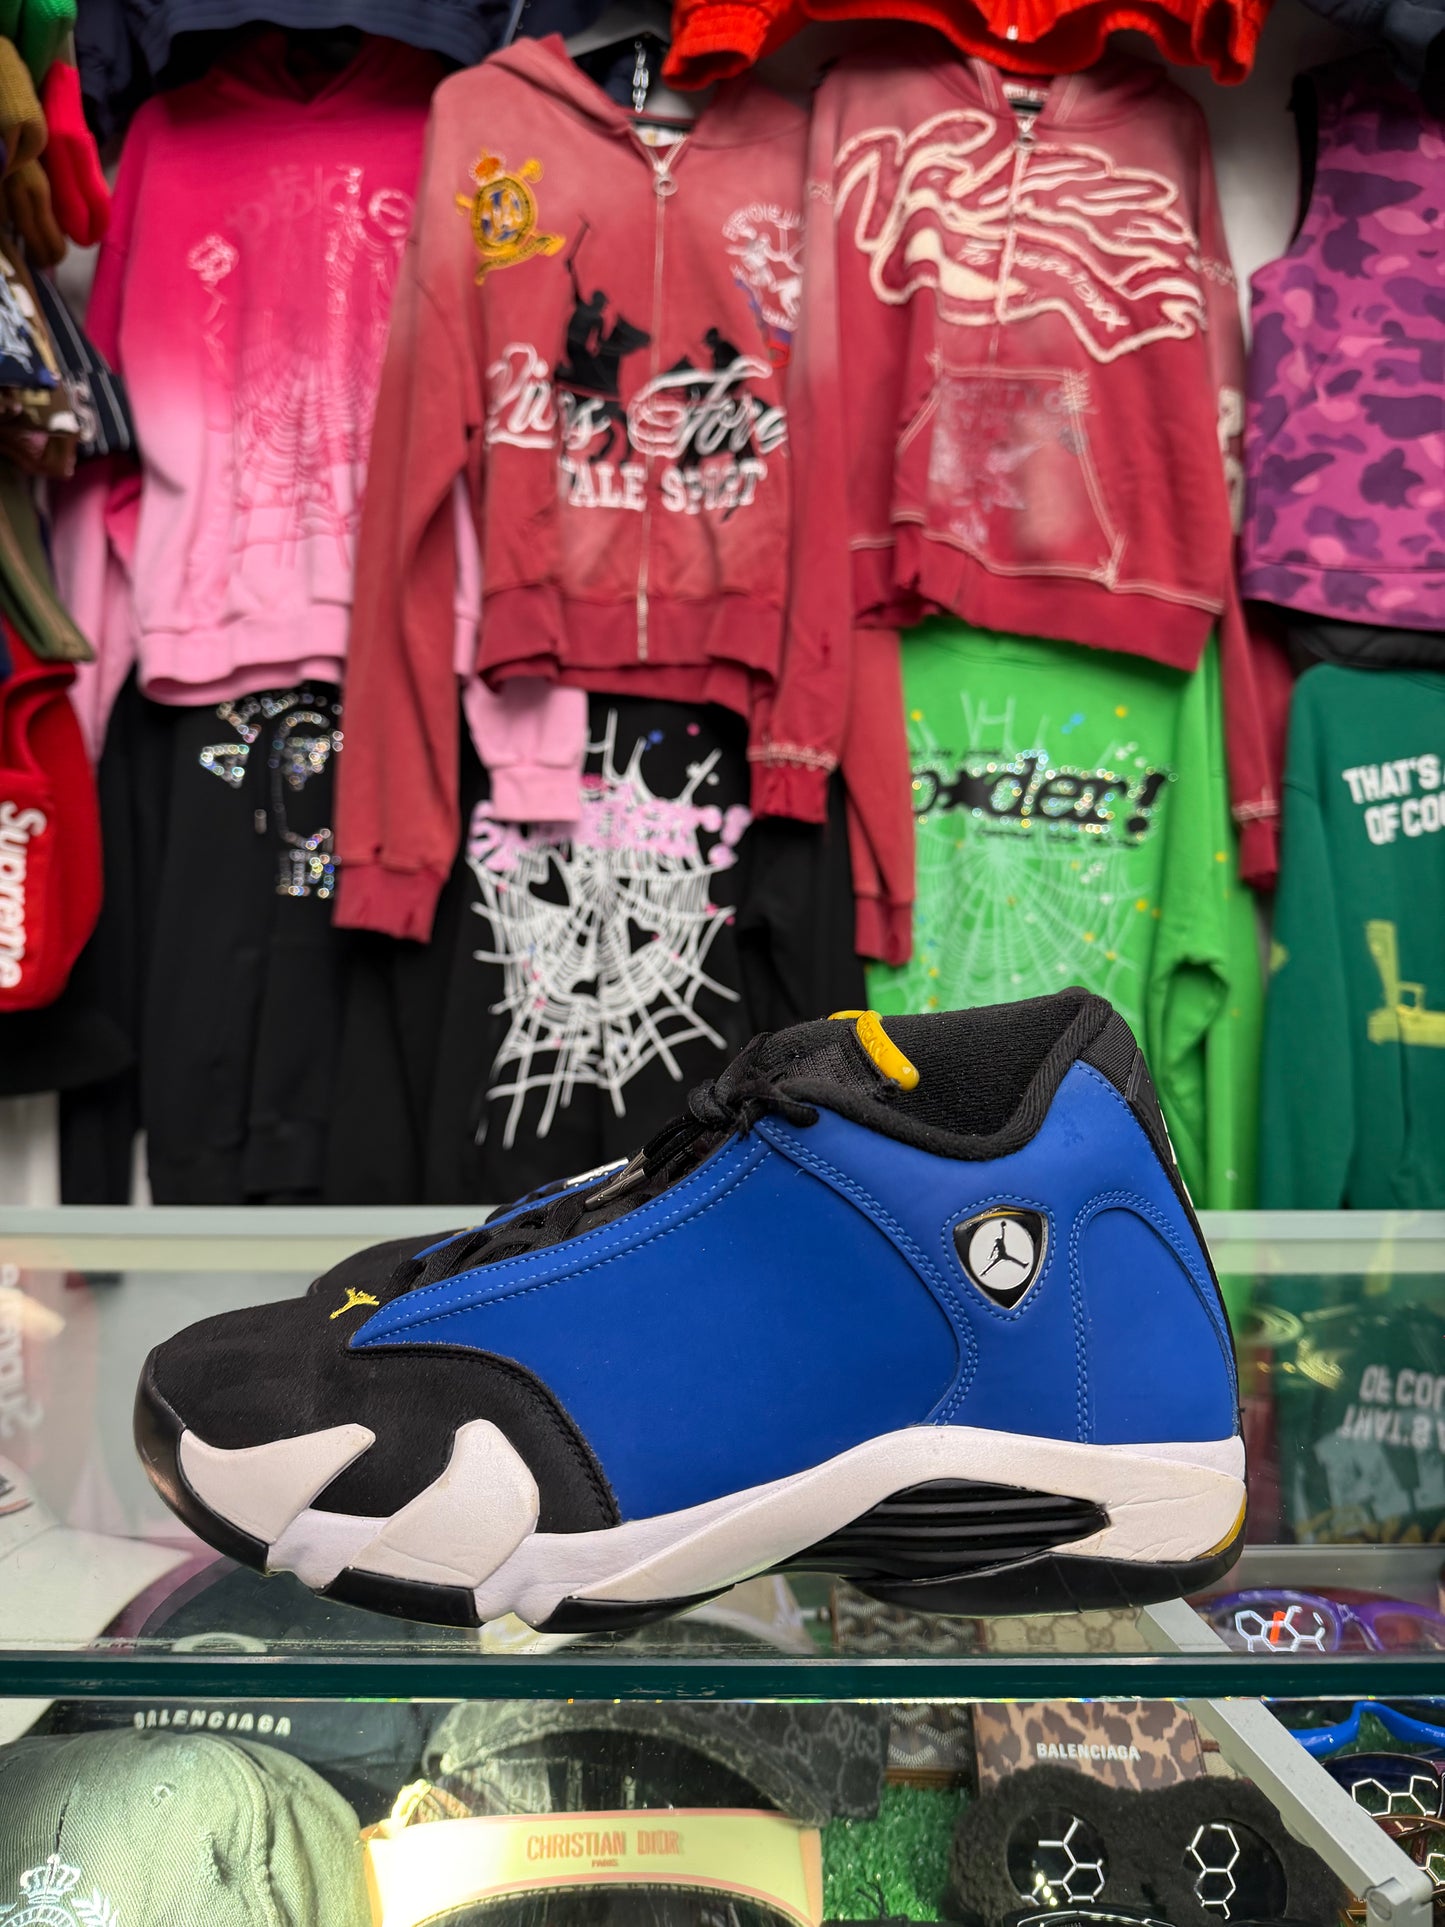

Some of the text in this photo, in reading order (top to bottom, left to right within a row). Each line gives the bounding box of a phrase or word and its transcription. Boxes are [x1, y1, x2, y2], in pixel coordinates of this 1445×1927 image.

[1341, 753, 1441, 805] THAT'S
[1363, 791, 1445, 846] OF CO
[133, 1708, 292, 1738] BALENCIAGA
[1036, 1742, 1141, 1762] BALENCIAGA
[526, 1829, 681, 1860] CHRISTIAN DIOR
